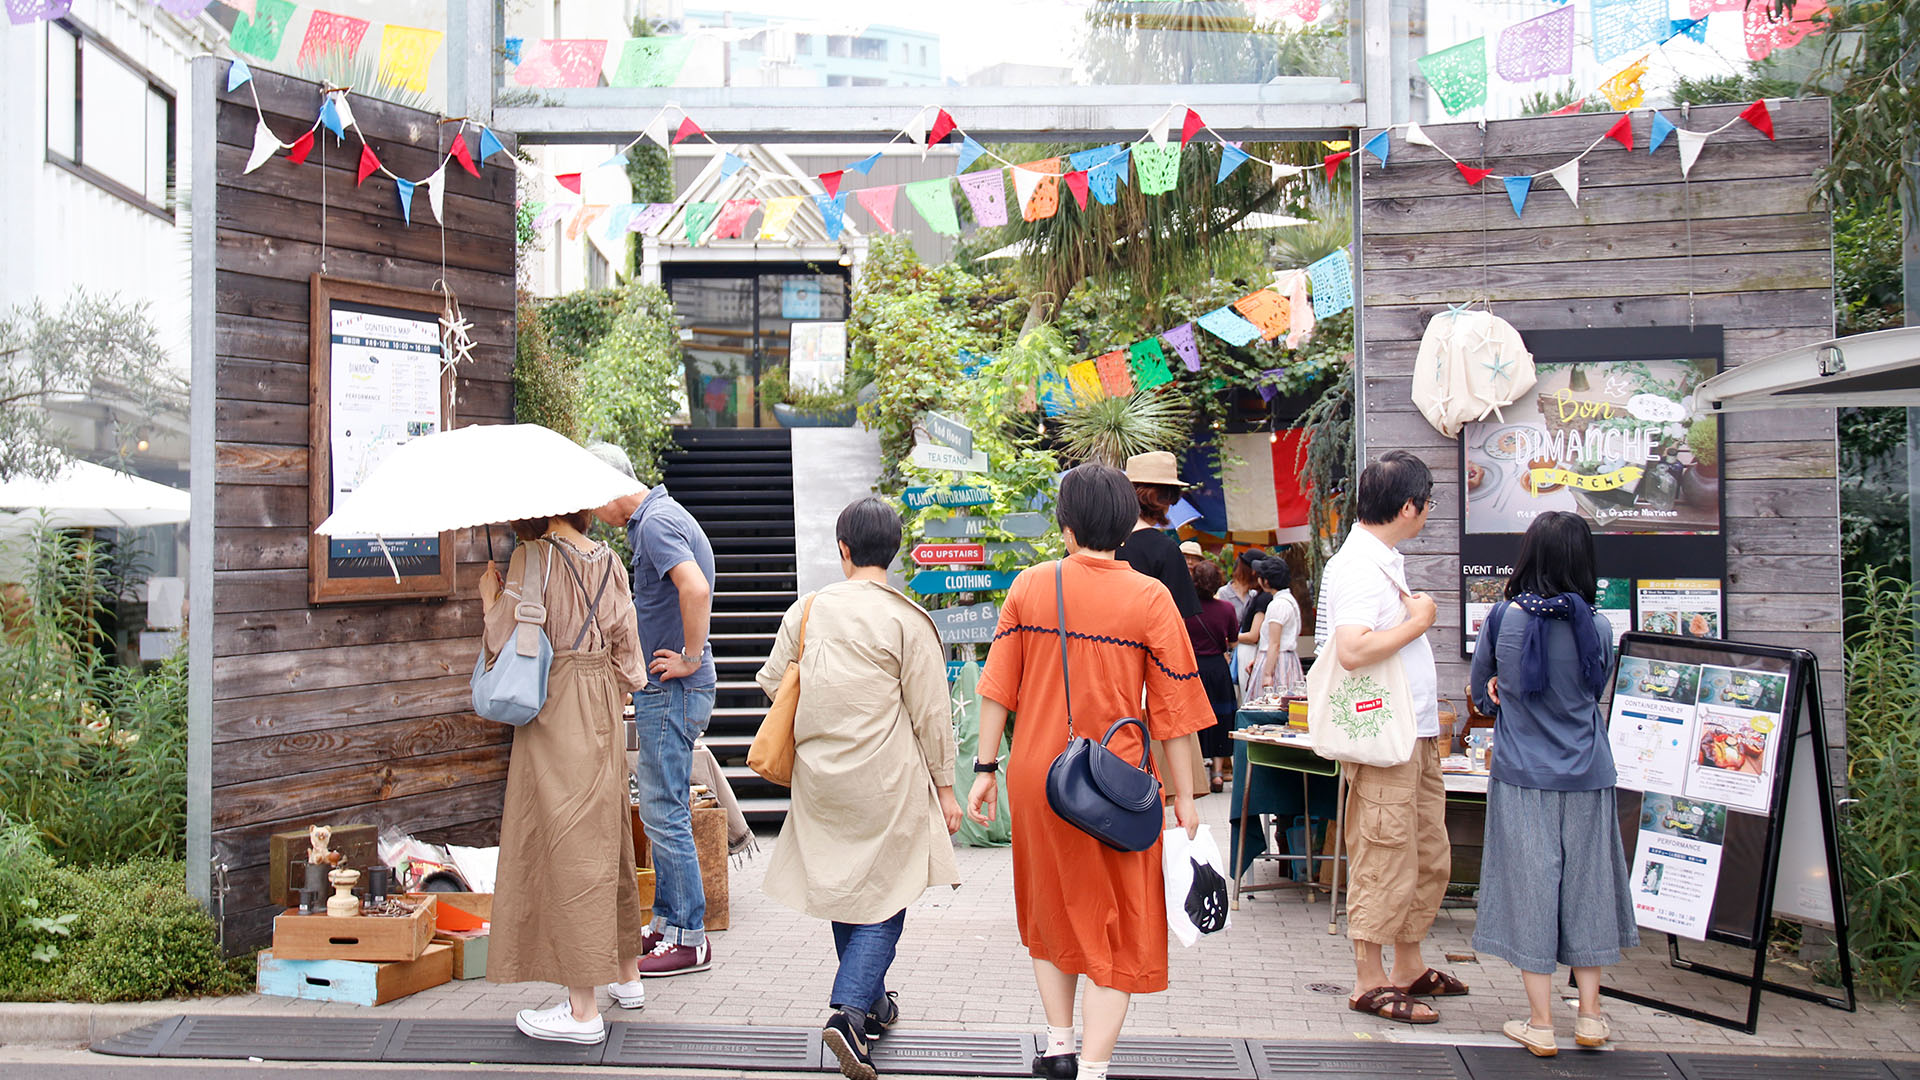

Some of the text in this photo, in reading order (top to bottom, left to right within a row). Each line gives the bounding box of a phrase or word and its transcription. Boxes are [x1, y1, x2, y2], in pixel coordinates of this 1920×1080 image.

[365, 323, 410, 335] CONTENTS MAP
[1553, 388, 1615, 423] Bon
[1515, 428, 1661, 465] DIMANCHE
[928, 452, 968, 465] TEA STAND
[1544, 470, 1625, 488] MARCHE
[1596, 509, 1607, 518] La
[920, 550, 933, 558] GO
[936, 549, 979, 558] UPSTAIRS
[1463, 565, 1514, 575] EVENT info
[945, 574, 992, 589] CLOTHING
[947, 608, 977, 623] cafe
[982, 606, 993, 619] &
[940, 627, 988, 641] TAINER
[1624, 700, 1658, 710] CONTAINER
[1660, 704, 1675, 713] ZONE
[1657, 837, 1701, 851] PERFORMANCE
